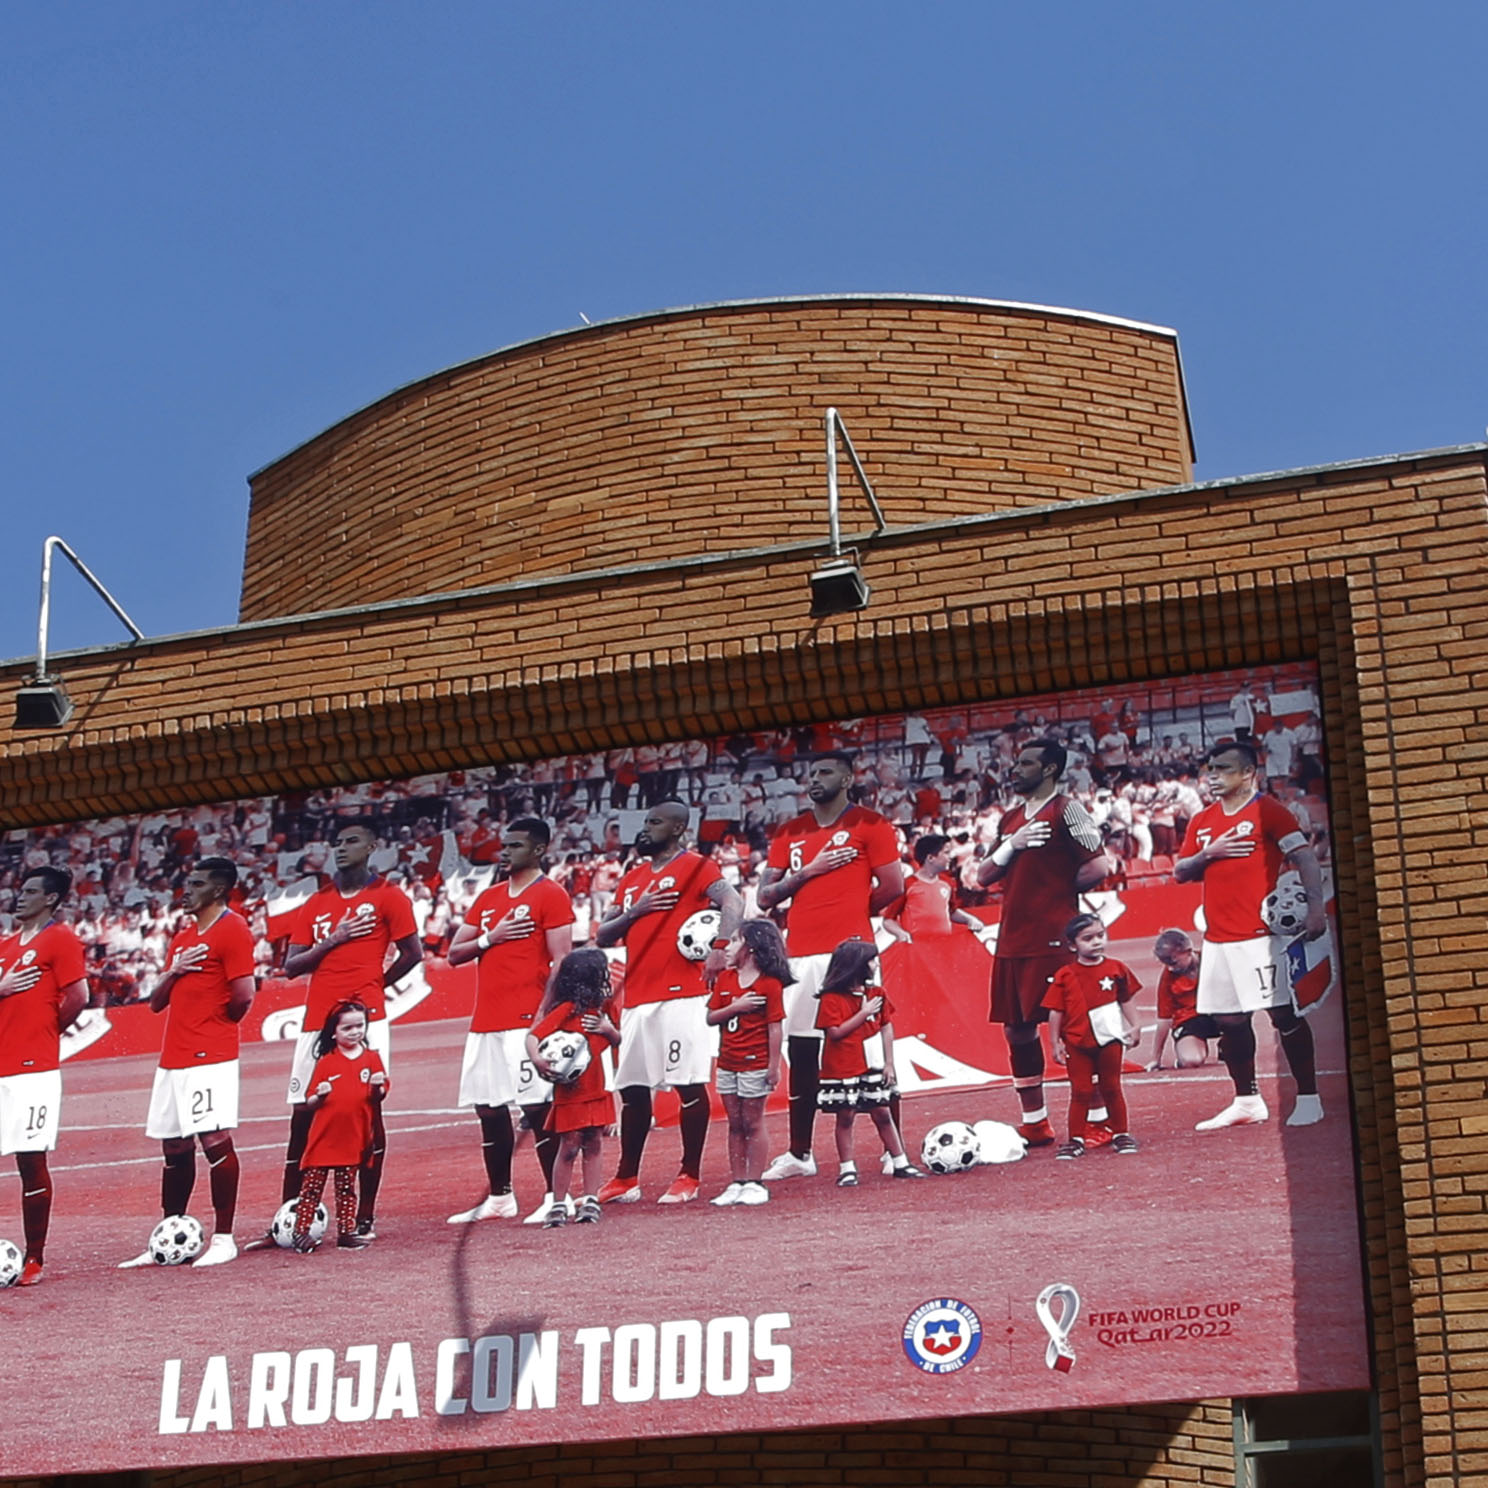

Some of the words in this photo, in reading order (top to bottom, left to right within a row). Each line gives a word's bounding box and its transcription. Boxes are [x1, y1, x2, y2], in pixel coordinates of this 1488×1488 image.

[790, 847, 803, 872] 6
[1255, 964, 1278, 991] 17
[668, 1040, 682, 1063] 8
[519, 1060, 534, 1083] 5
[191, 1088, 214, 1116] 21
[25, 1105, 48, 1131] 18
[1088, 1311, 1129, 1328] FIFA
[1131, 1305, 1200, 1324] WORLD
[1204, 1302, 1242, 1318] CUP
[158, 1355, 234, 1435] LA
[247, 1341, 420, 1429] ROJA
[435, 1330, 559, 1416] CON
[574, 1311, 792, 1406] TODOS
